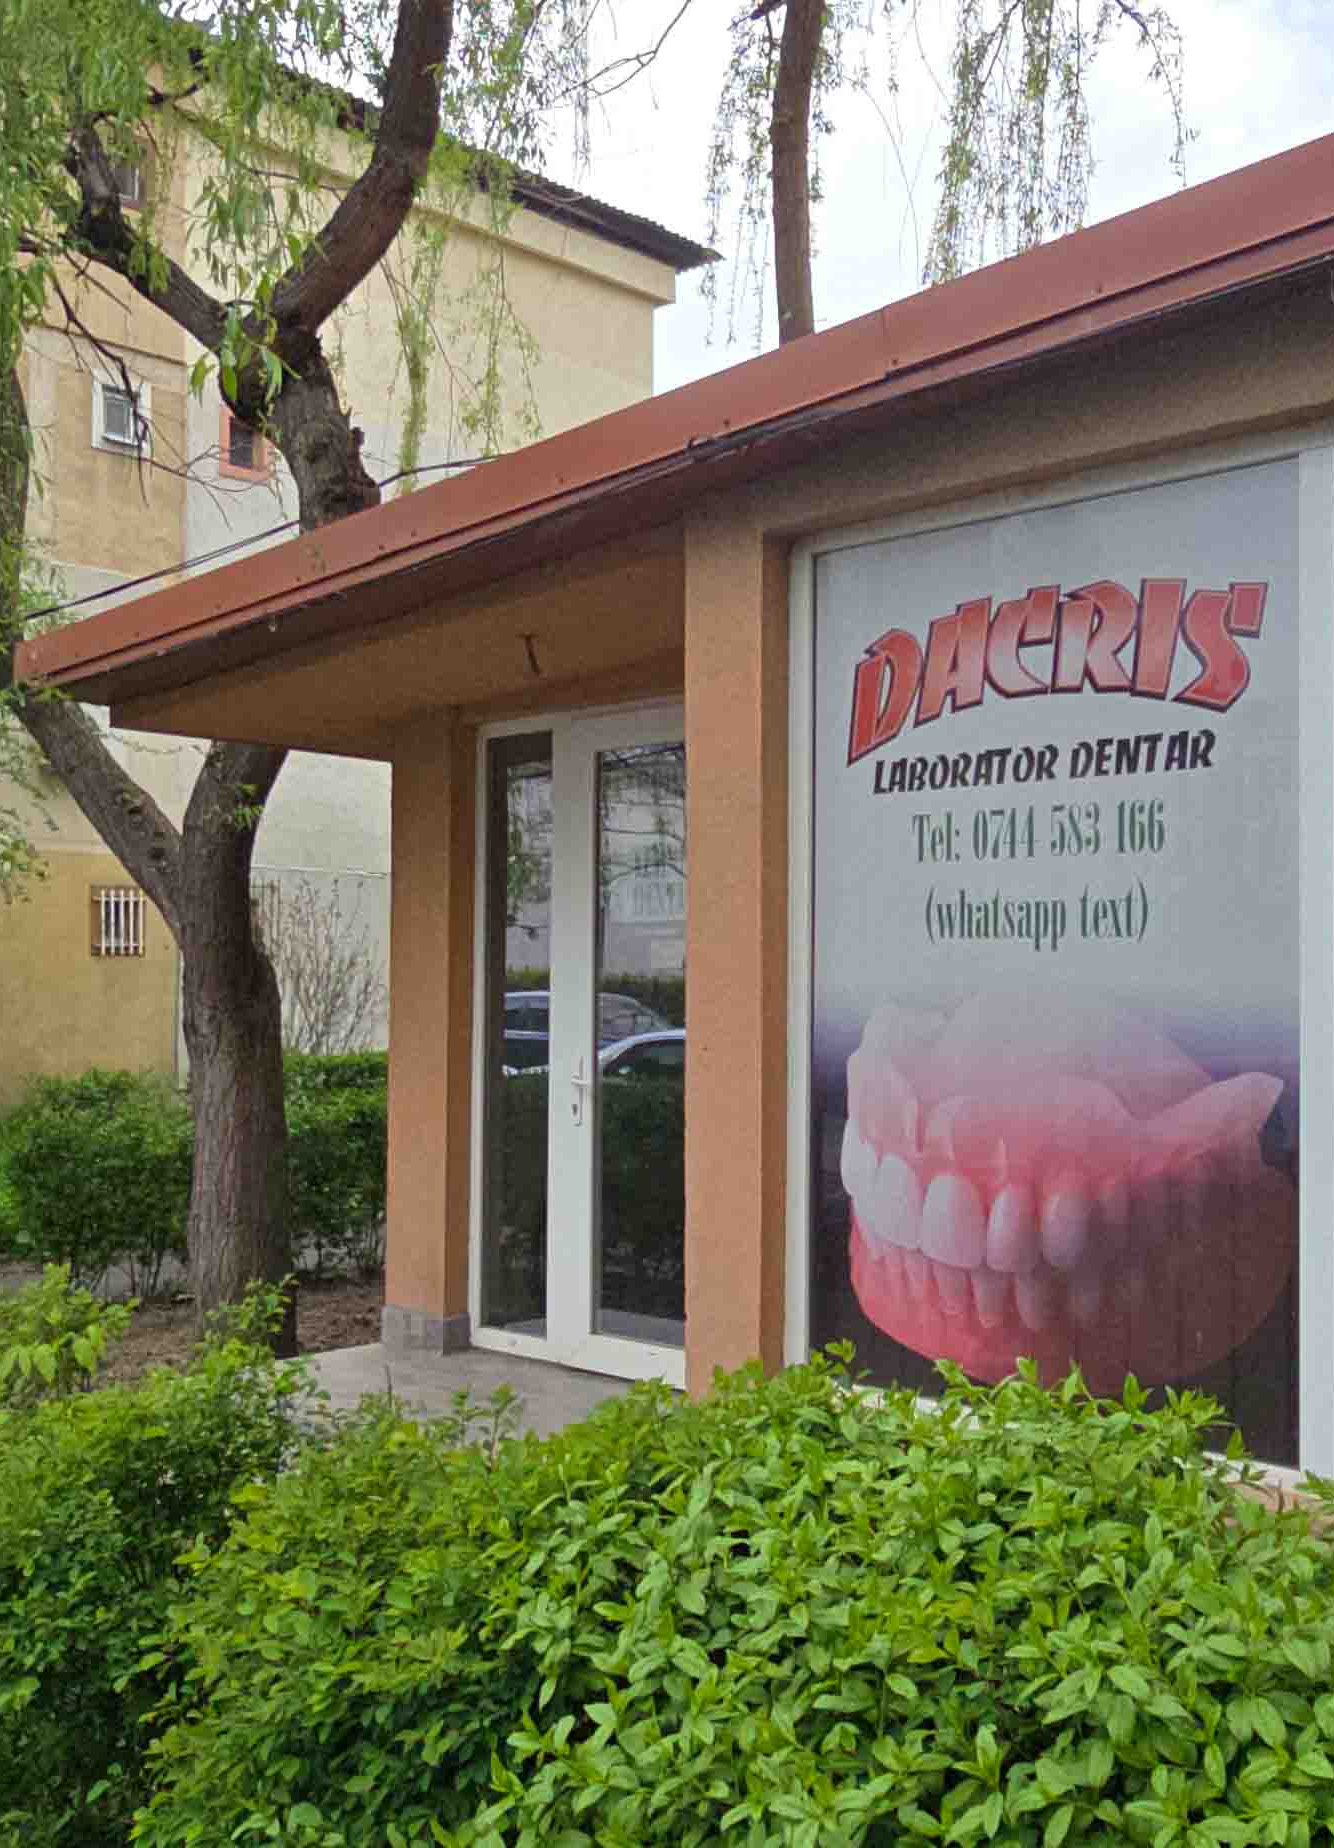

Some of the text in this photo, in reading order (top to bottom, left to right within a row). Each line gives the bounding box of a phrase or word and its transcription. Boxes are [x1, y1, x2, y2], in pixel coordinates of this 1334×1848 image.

[847, 577, 1268, 767] DACRIS
[873, 729, 1216, 795] LABORATOR DENTAR
[913, 798, 1166, 862] Tel: 0744 583 166
[925, 876, 1149, 952] (whatsapp text)
